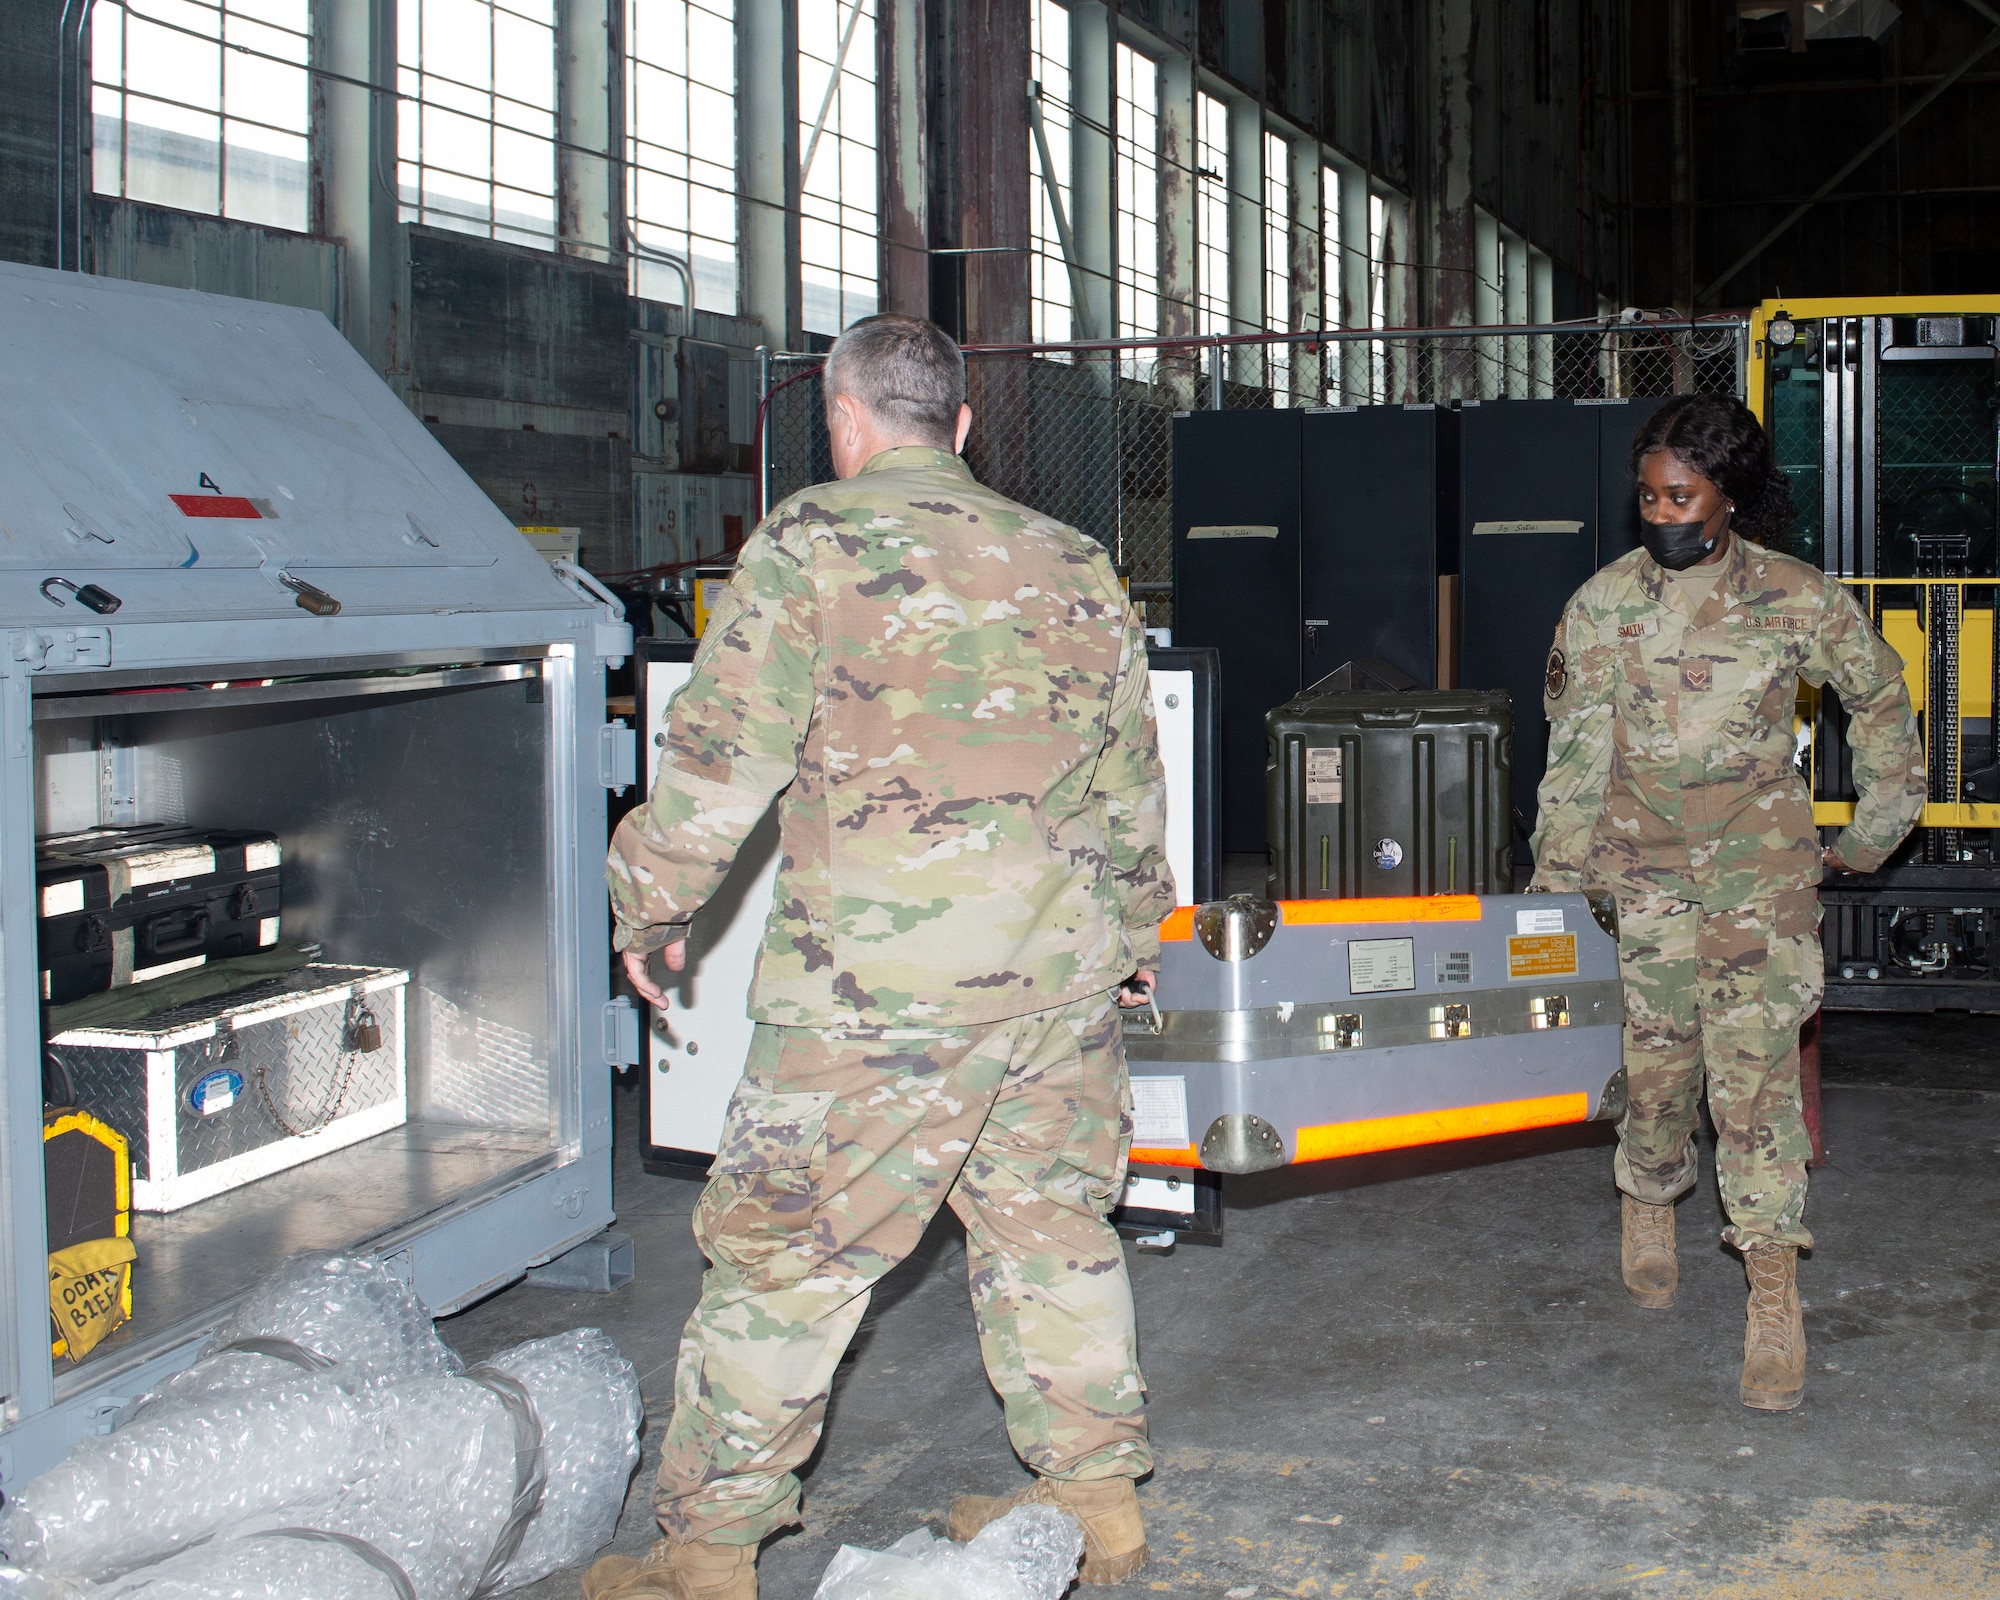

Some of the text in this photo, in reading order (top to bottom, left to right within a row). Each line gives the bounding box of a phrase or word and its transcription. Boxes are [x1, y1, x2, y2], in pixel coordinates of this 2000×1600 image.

[200, 472, 222, 494] 4
[1617, 622, 1645, 638] SMITH
[1745, 616, 1808, 630] U.S. AIR FORCE
[147, 889, 170, 897] OLYMPUS
